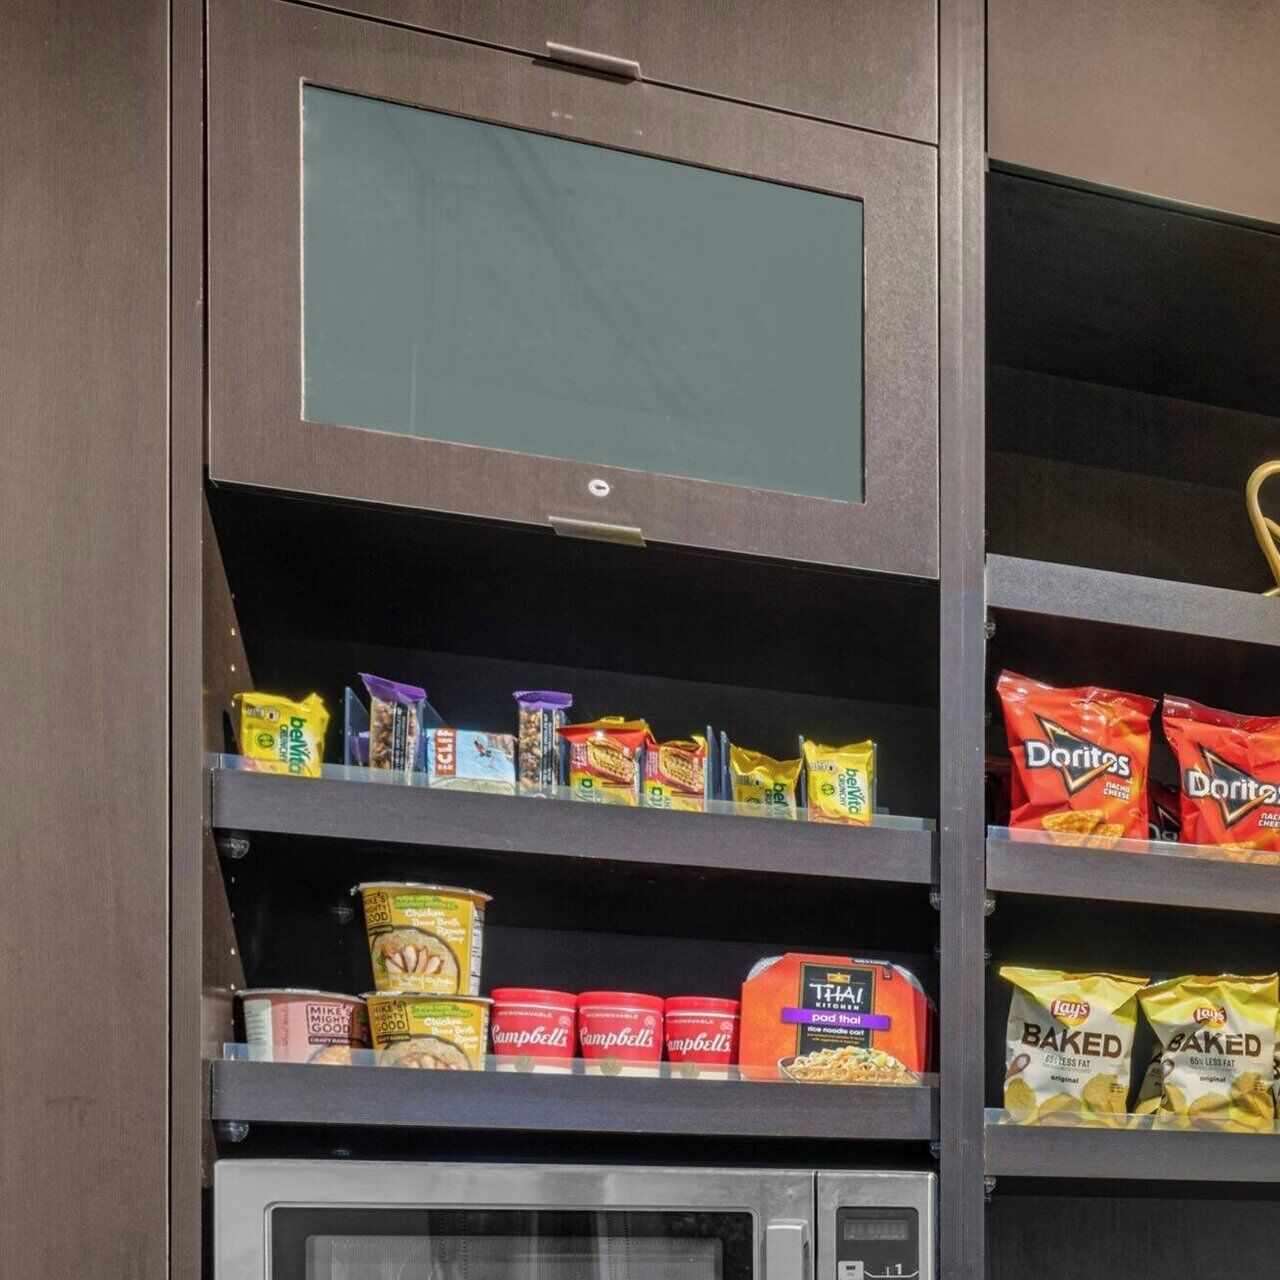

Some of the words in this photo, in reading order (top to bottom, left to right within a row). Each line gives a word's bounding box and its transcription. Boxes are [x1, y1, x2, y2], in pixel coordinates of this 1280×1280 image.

[289, 715, 311, 775] belVita
[437, 727, 454, 764] CLIF
[1026, 740, 1131, 778] Doritos
[838, 773, 847, 807] CRUNCHY
[846, 768, 865, 815] belVita
[1105, 781, 1131, 793] NACHO
[1103, 788, 1130, 801] CHEESE
[809, 983, 864, 1004] THAI
[310, 1003, 353, 1016] MIKE'S
[815, 1002, 860, 1011] KITCHEN
[1052, 1000, 1089, 1020] Lay's
[311, 1014, 353, 1024] MIGHTY
[374, 1013, 405, 1023] MIGHTY
[811, 1013, 836, 1023] pad
[839, 1014, 861, 1025] thai
[1196, 1007, 1226, 1023] Lay's
[311, 1023, 351, 1034] GOOD
[375, 1020, 406, 1033] GOOD
[822, 1027, 848, 1035] noodle
[849, 1028, 865, 1036] cart
[492, 1026, 569, 1048] Campbell's
[579, 1027, 655, 1050] Campbell's
[1021, 1022, 1123, 1059] BAKED
[1166, 1032, 1262, 1058] BAKED
[1059, 1057, 1077, 1068] LESS
[1077, 1060, 1091, 1069] FAT
[1204, 1058, 1222, 1068] LESS
[1222, 1059, 1236, 1068] FAT
[1050, 1075, 1079, 1085] original
[1199, 1077, 1227, 1085] original
[895, 1263, 903, 1275] 1
